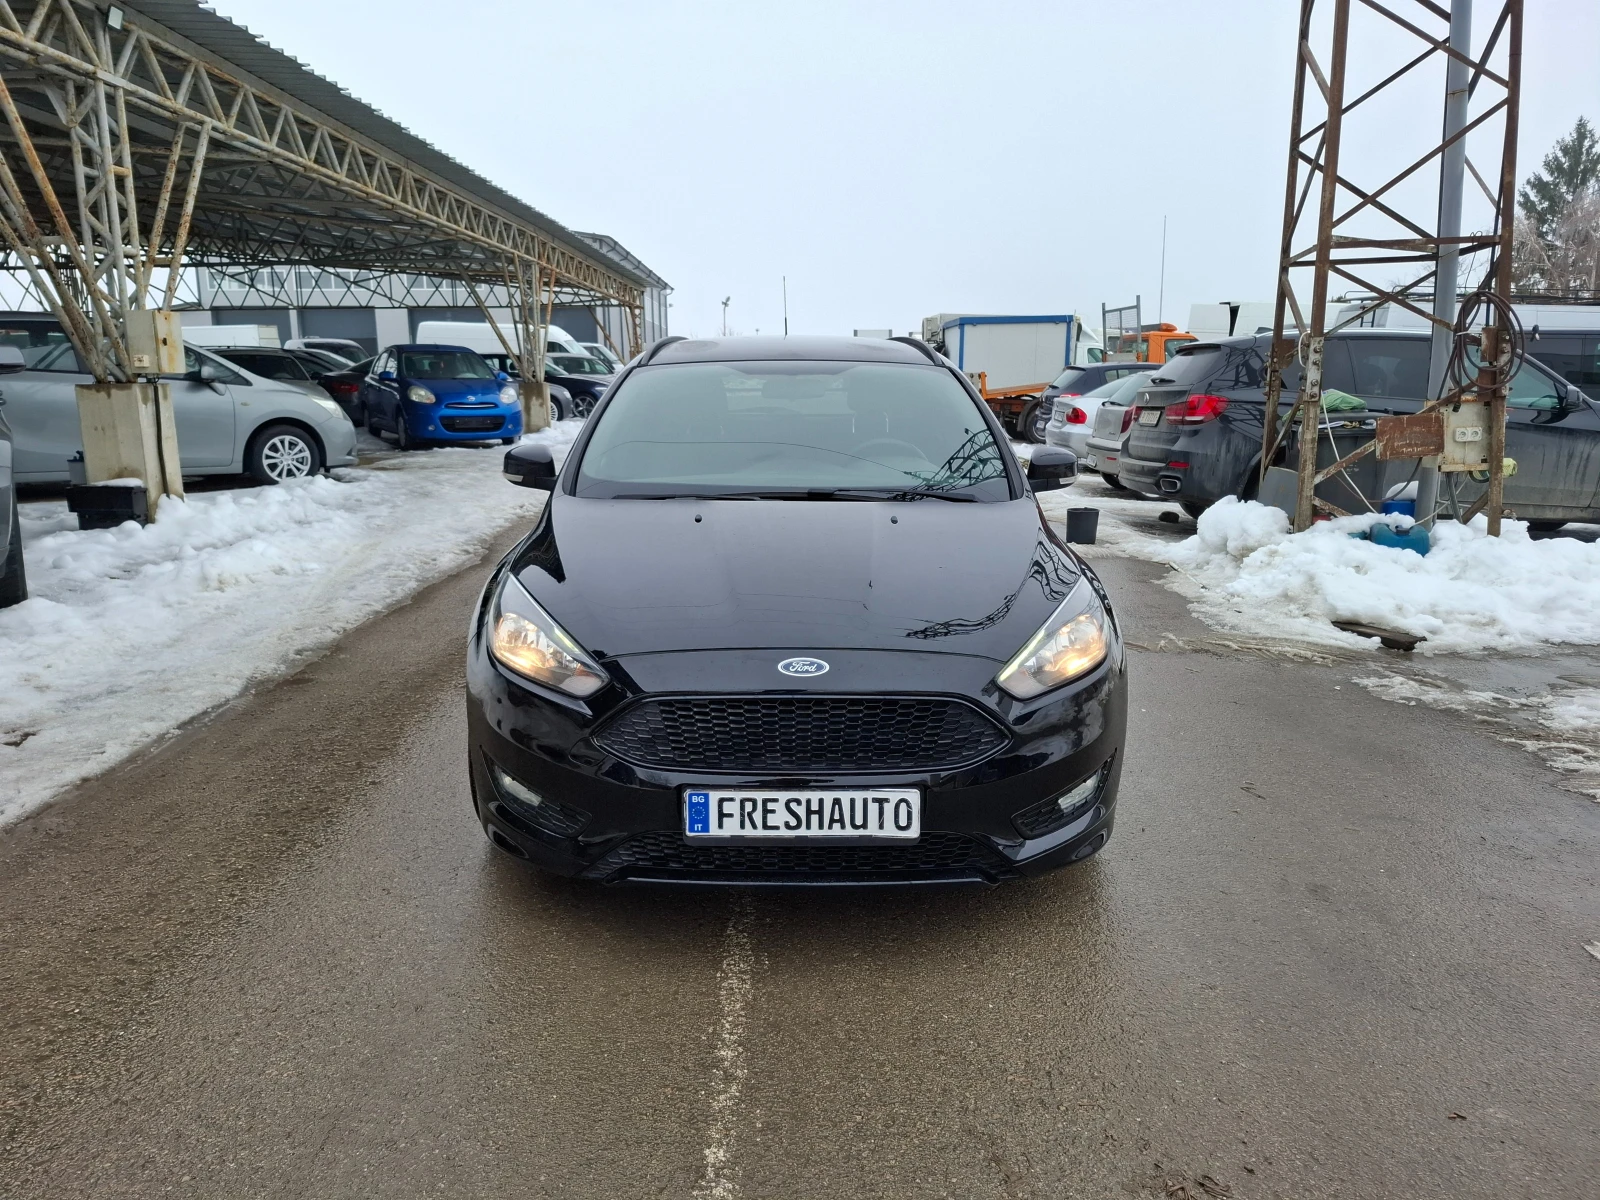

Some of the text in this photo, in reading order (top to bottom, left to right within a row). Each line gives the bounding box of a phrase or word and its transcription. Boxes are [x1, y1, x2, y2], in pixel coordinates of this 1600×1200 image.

[790, 662, 817, 671] Ford
[717, 797, 912, 831] FRESHAUTO
[694, 823, 703, 831] IT
